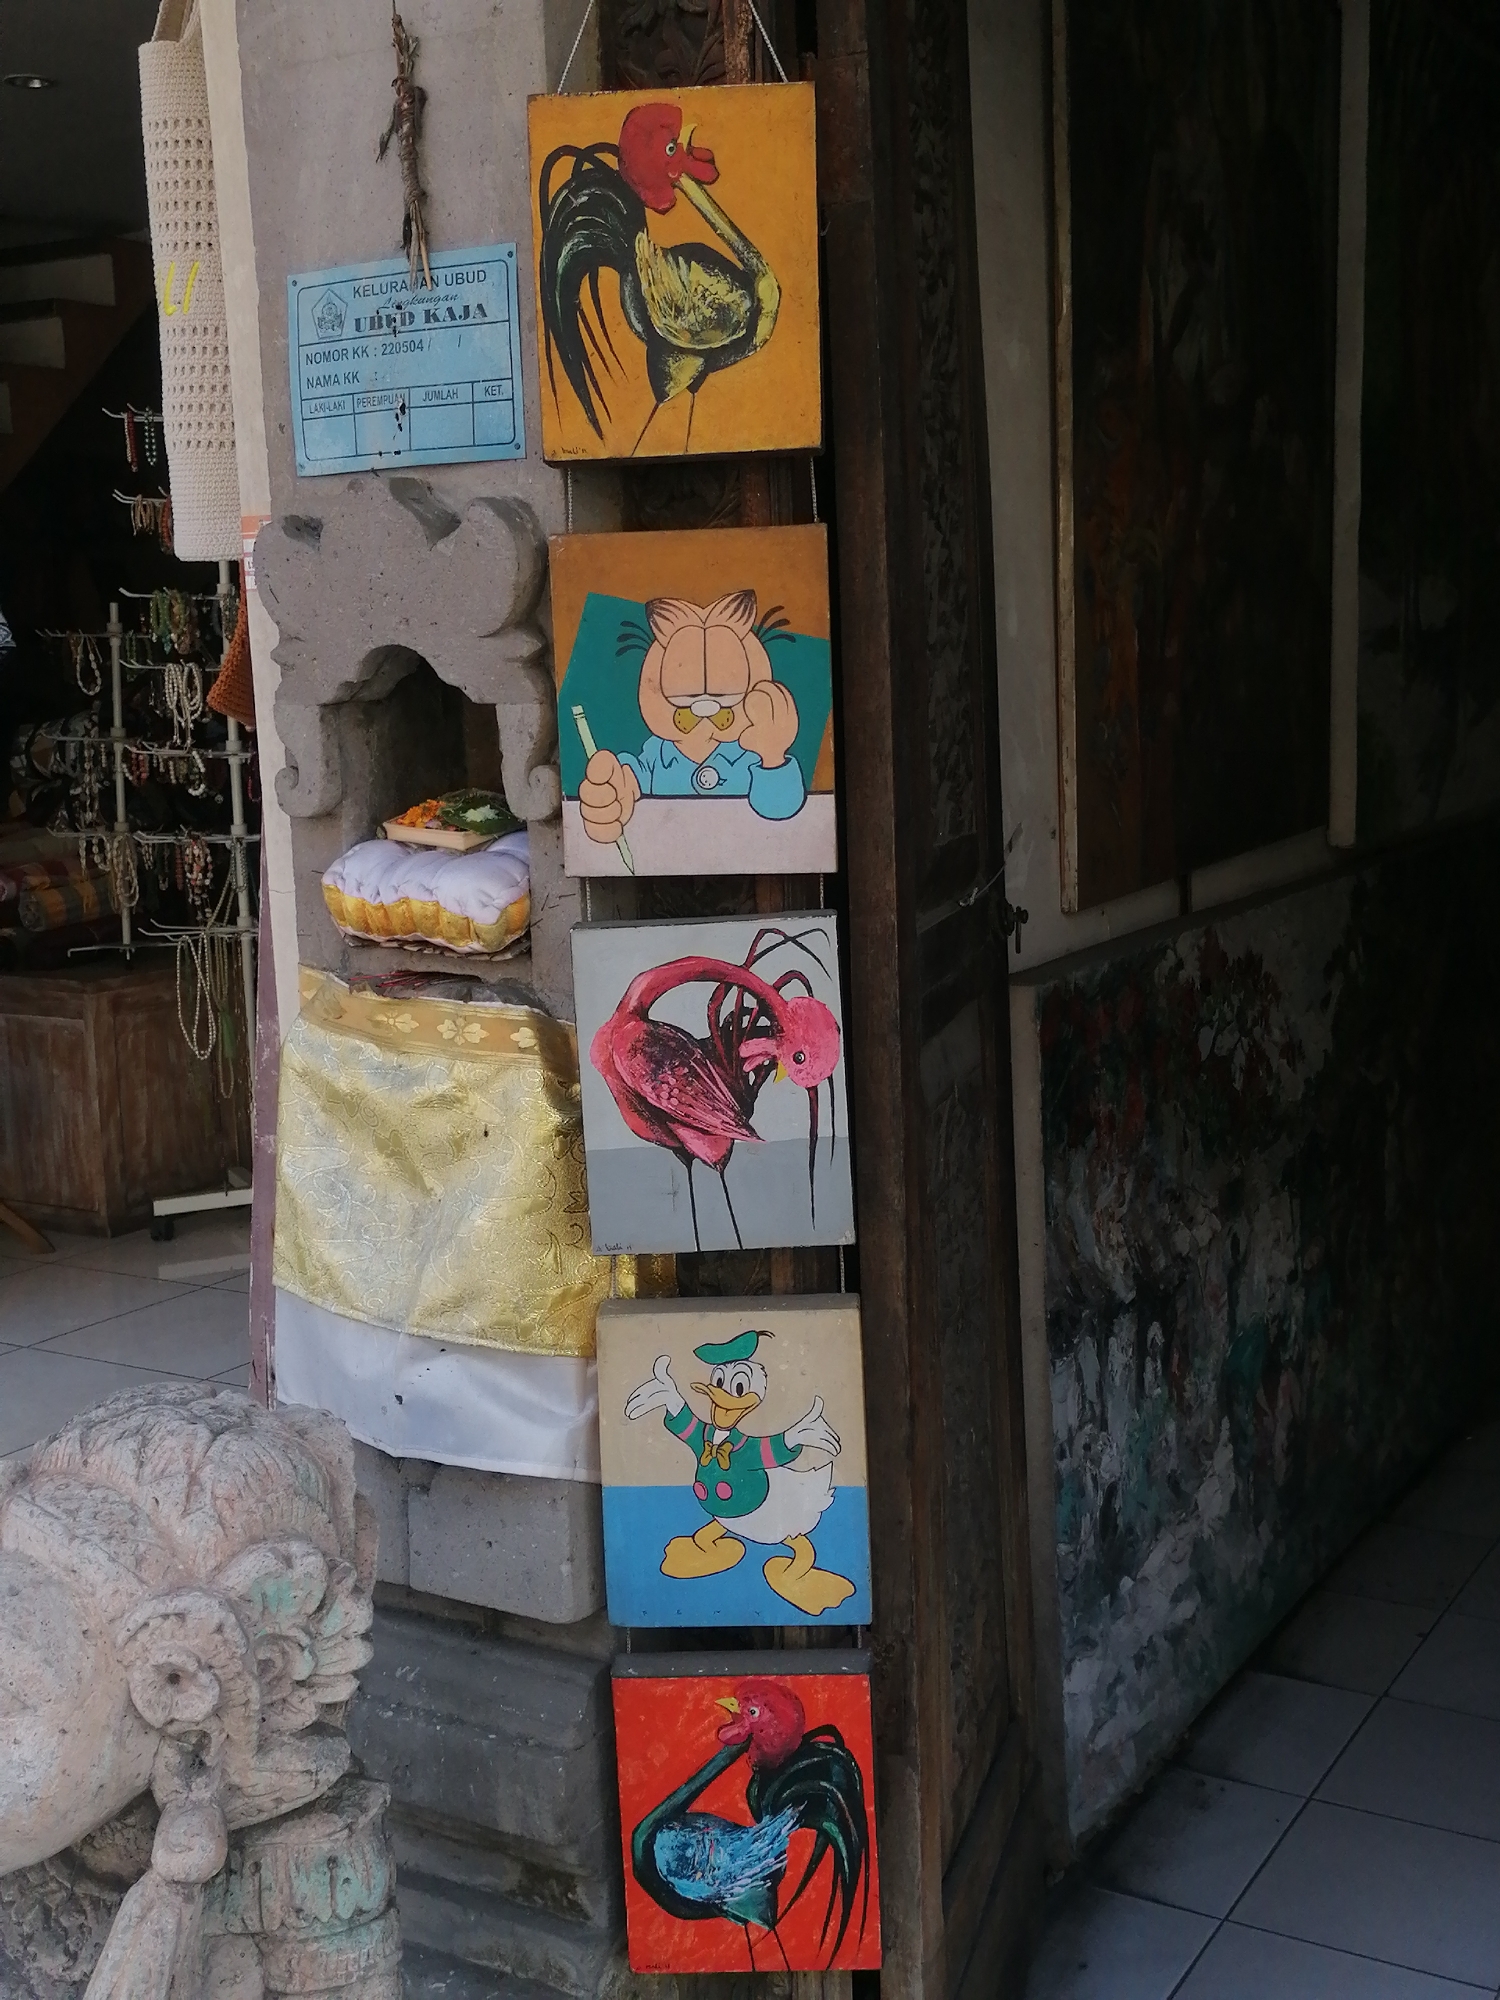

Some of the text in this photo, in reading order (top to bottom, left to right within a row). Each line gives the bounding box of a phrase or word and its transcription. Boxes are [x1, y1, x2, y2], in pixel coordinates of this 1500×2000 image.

[353, 269, 487, 299] KELURAAN UBUD
[423, 303, 488, 324] KAJA
[305, 347, 348, 366] NOMOR
[352, 345, 369, 360] KK
[306, 373, 343, 390] NAMA
[343, 371, 360, 385] KK
[309, 400, 346, 414] LAKI-LAKI
[422, 388, 459, 402] JUMLAH
[484, 384, 504, 397] KET.
